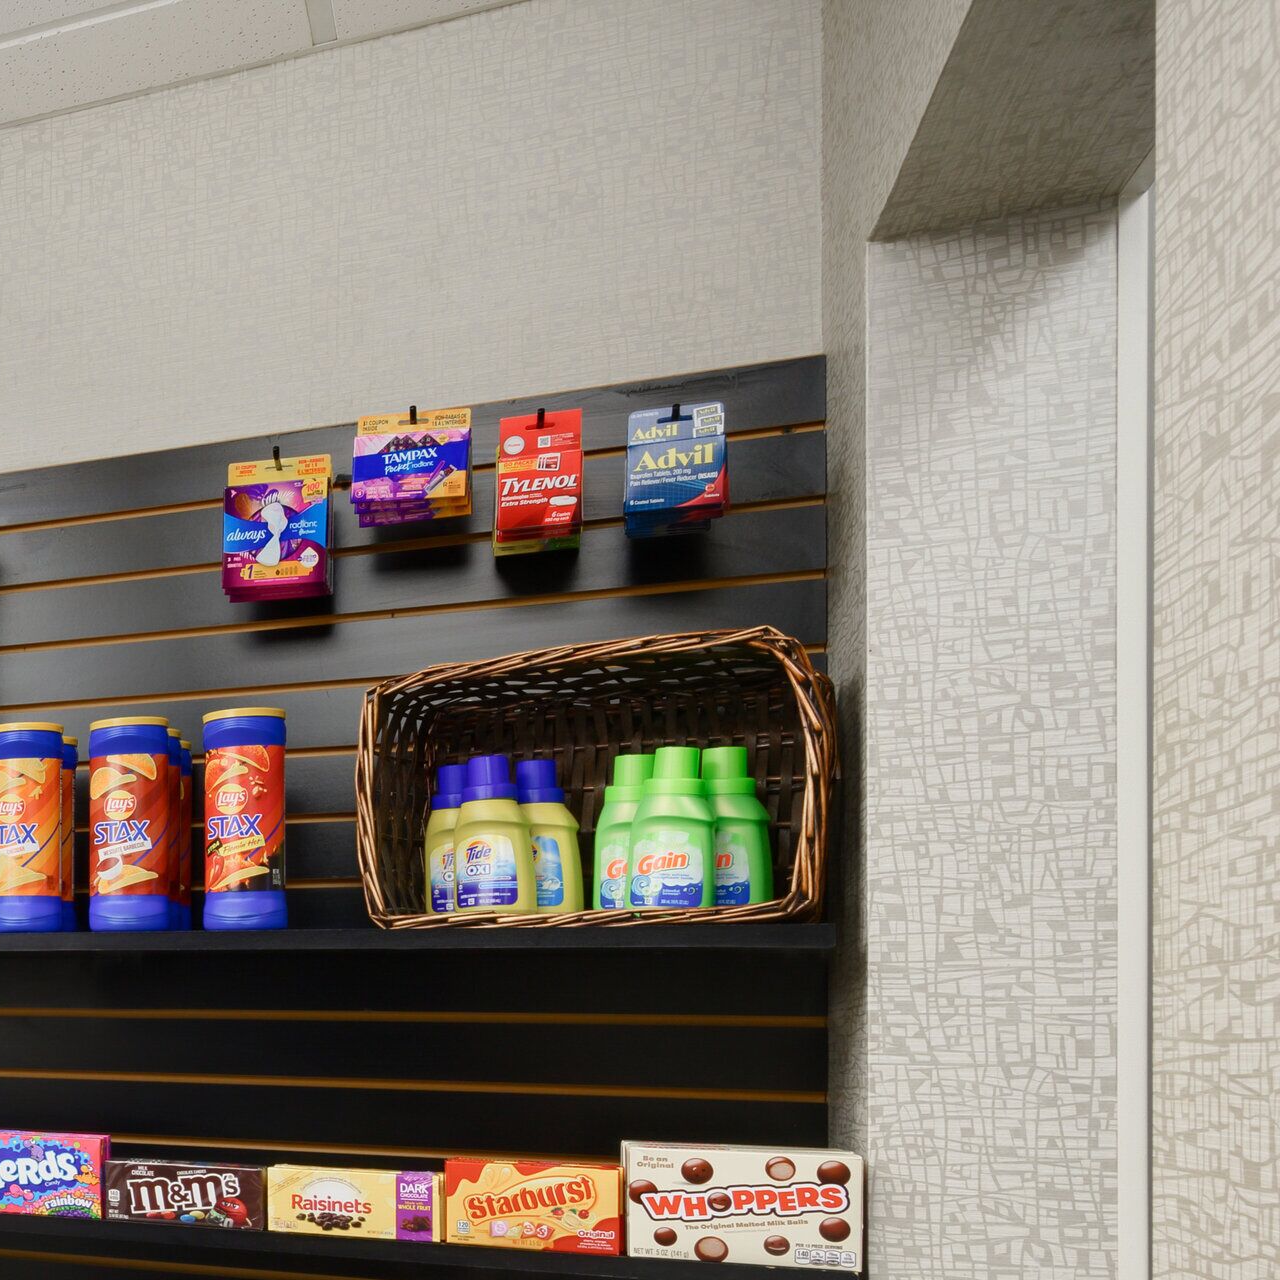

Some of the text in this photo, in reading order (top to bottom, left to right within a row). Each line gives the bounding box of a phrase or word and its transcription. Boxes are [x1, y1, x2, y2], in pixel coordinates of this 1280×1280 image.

[632, 424, 678, 440] Advil
[382, 447, 438, 464] TAMPAX
[633, 443, 714, 472] Advil
[501, 474, 577, 496] TYLENOL
[290, 520, 317, 529] radiant
[227, 529, 266, 543] always
[247, 565, 253, 579] 1
[106, 797, 135, 814] Lay's
[217, 791, 246, 808] Lay's
[94, 821, 150, 844] STAX
[208, 814, 262, 840] STAX
[248, 838, 262, 848] Hot
[465, 846, 491, 864] Tide
[638, 852, 689, 875] Gain
[466, 864, 490, 875] OXI
[636, 1161, 674, 1169] Original
[128, 1174, 240, 1214] m&m's
[400, 1183, 428, 1194] DARK
[45, 1195, 93, 1210] rainbow
[291, 1194, 372, 1214] Raisinets
[466, 1176, 593, 1221] Starburst
[645, 1186, 844, 1217] WHOPPERS
[577, 1230, 614, 1239] Original
